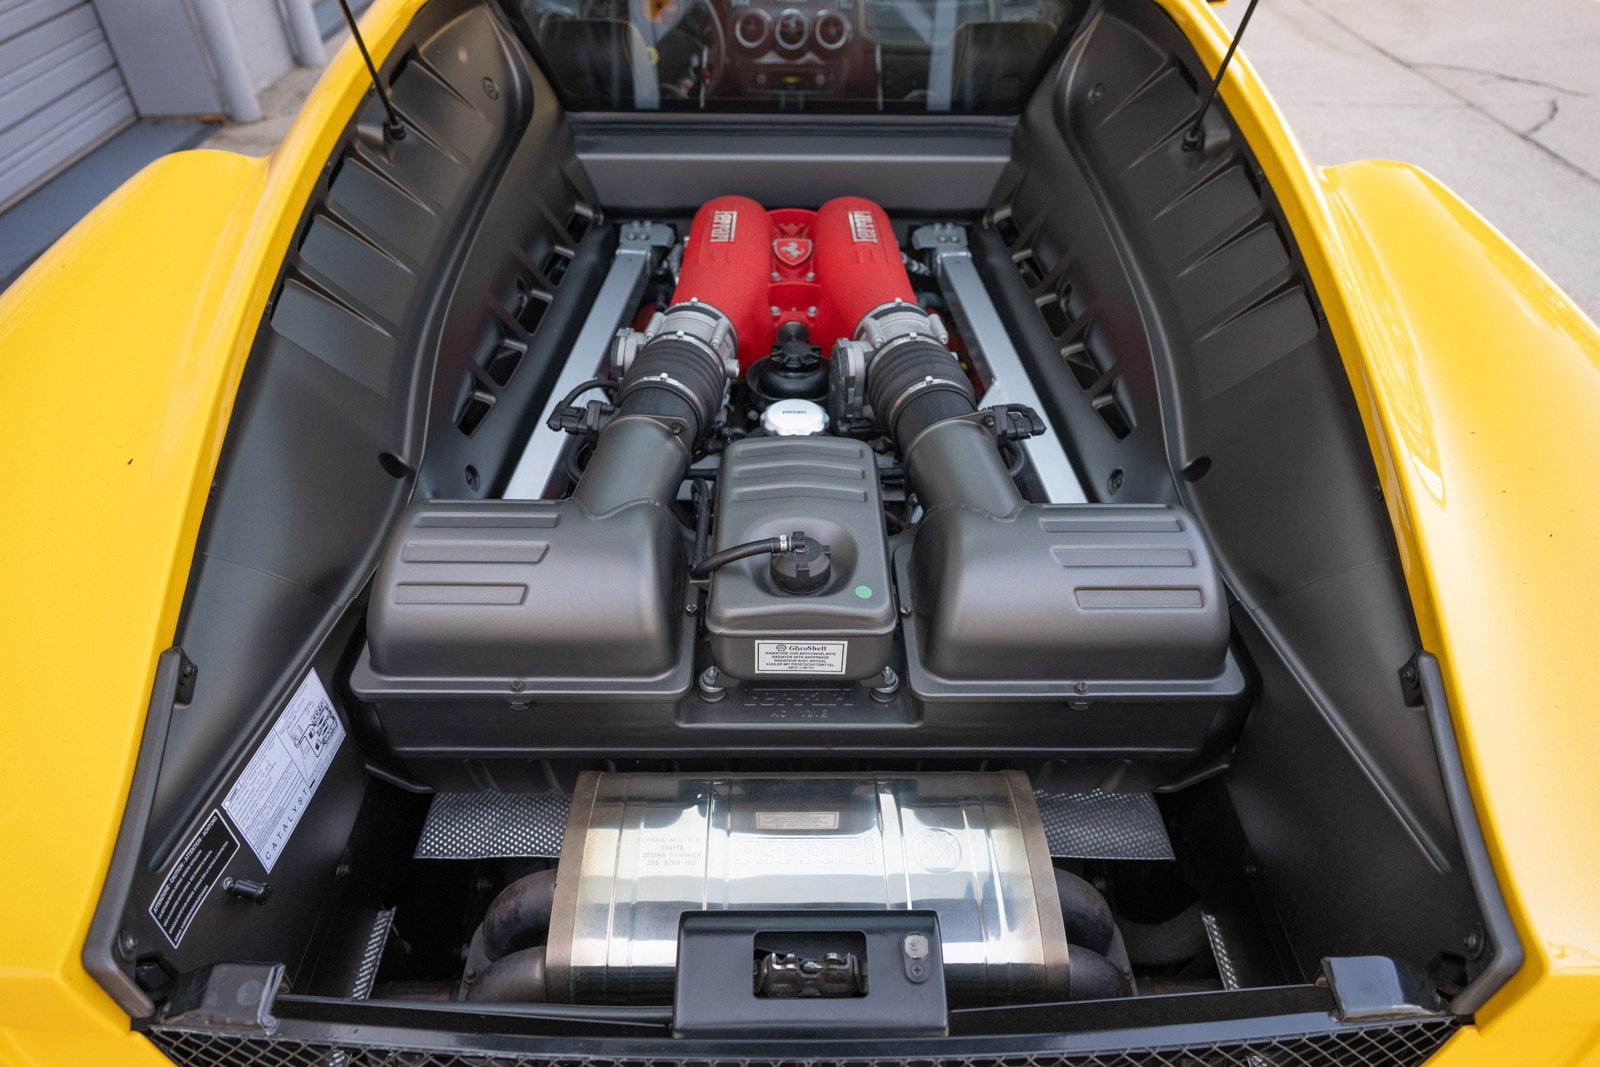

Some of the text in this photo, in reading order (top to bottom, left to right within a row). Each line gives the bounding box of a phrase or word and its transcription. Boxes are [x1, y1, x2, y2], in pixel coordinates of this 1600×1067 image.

[153, 816, 217, 914] ATTENZIONE CAUTION ATTENTION ACHTUNG
[265, 789, 309, 861] CATALYST
